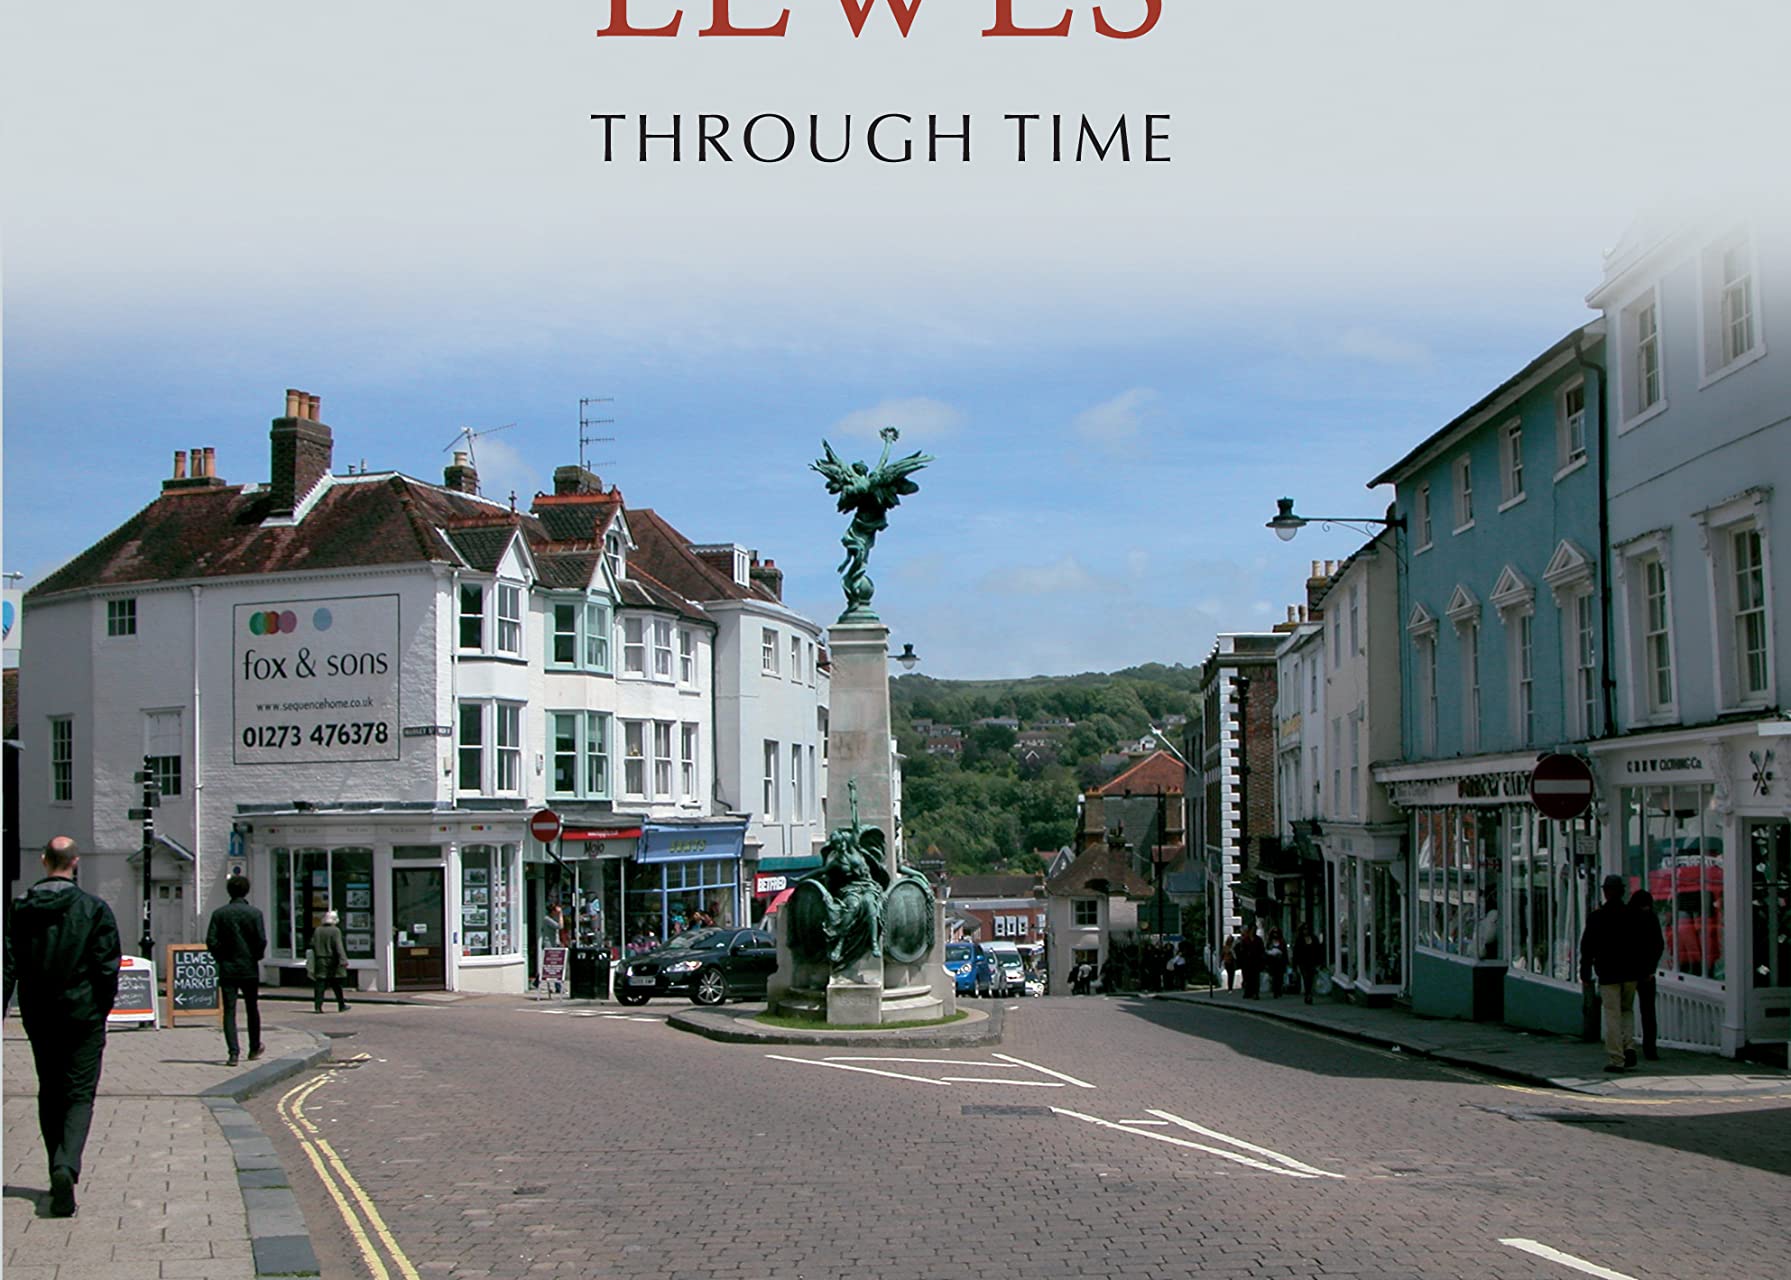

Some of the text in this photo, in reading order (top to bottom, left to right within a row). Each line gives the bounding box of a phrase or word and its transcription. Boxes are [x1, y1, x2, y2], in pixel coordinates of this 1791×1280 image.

[243, 647, 389, 681] fox & sons
[256, 697, 374, 712] www.sequencehome.co.uk
[243, 721, 389, 748] 01273 476378
[1627, 759, 1658, 773] CREW
[584, 840, 605, 857] Mojo
[175, 952, 216, 965] LEWES
[176, 965, 216, 979] FOOD
[174, 977, 219, 989] MARKET
